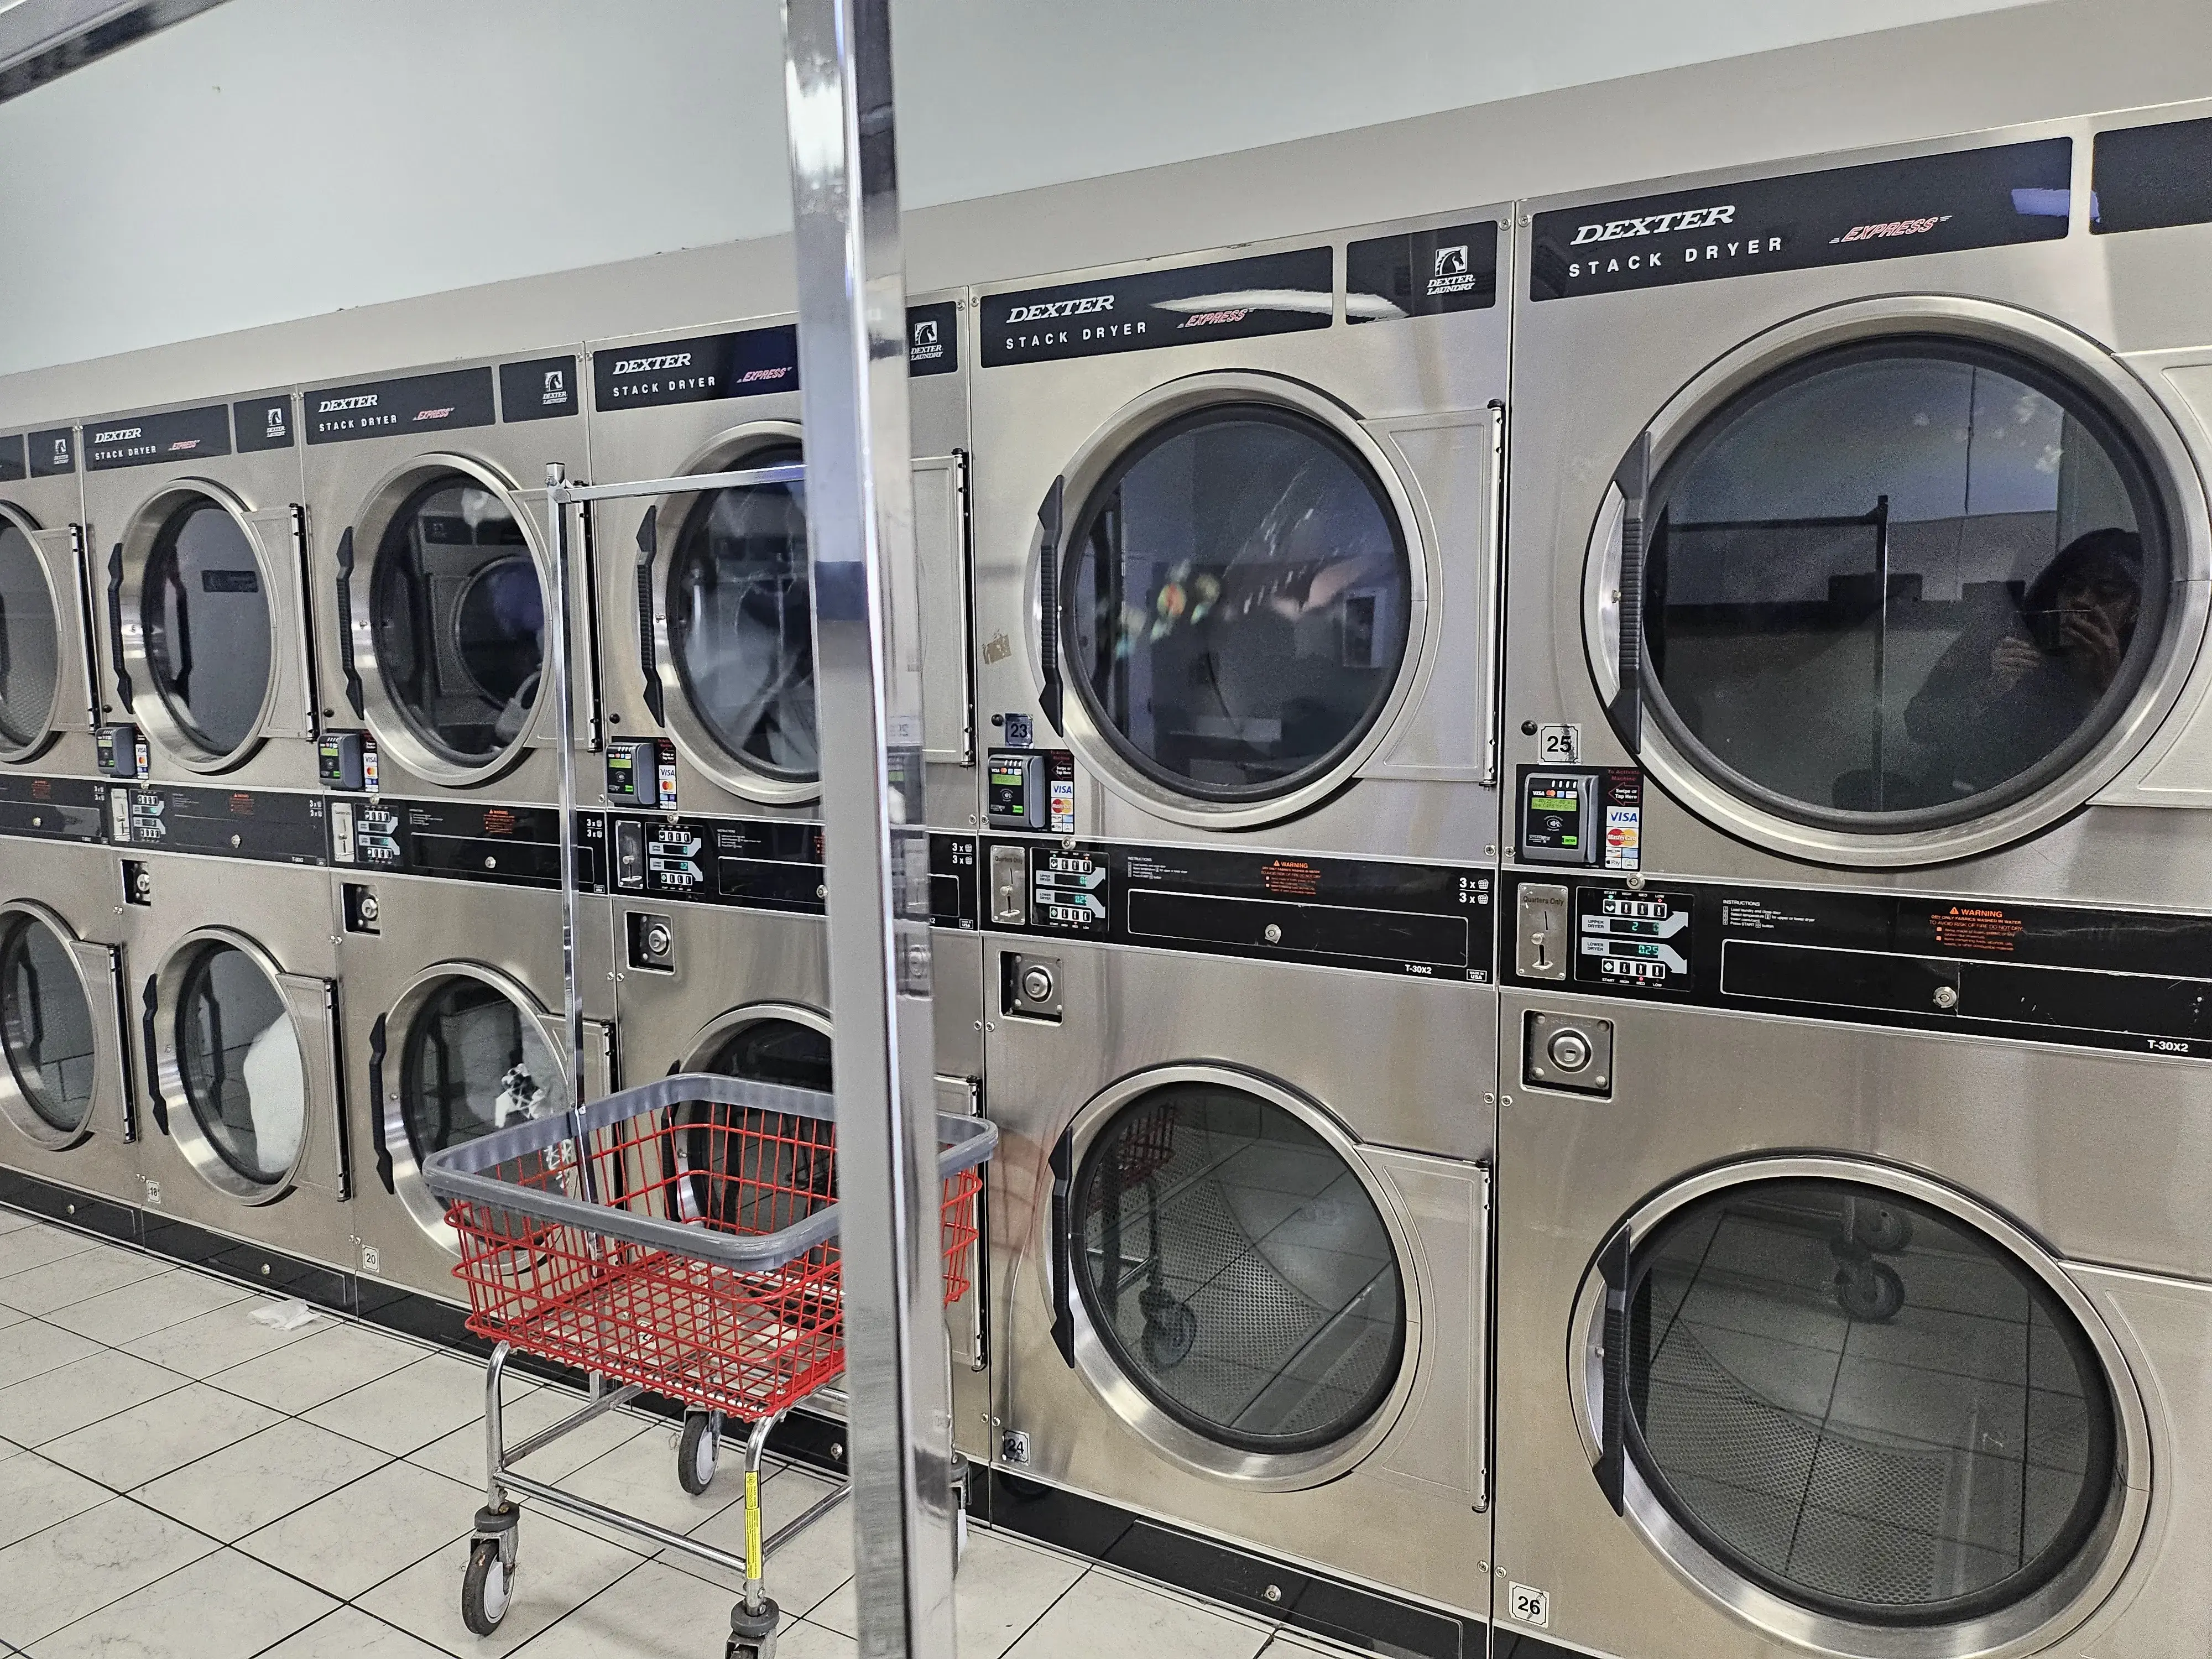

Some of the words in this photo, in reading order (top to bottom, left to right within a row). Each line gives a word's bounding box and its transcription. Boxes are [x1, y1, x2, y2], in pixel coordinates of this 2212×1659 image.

[1569, 205, 1735, 245] DEXTER
[1840, 217, 1938, 243] EXPRESS
[1569, 253, 1662, 277] STACK
[1685, 237, 1782, 263] DRYER
[1427, 274, 1474, 288] DEXTER
[1427, 283, 1475, 295] LAUNDRY
[1006, 295, 1115, 324] DEXTER
[1185, 308, 1248, 328] EXPRESS
[1006, 331, 1068, 349] STACK
[1083, 322, 1146, 341] DRYER
[910, 351, 943, 361] LAUNDRY
[911, 345, 942, 354] DEXTER
[612, 353, 691, 375] DEXTER
[742, 367, 787, 383] EXPRESS
[613, 383, 659, 397] STACK
[669, 376, 716, 391] DRYER
[318, 394, 378, 413] DEXTER
[417, 409, 450, 421] EXPRESS
[319, 419, 355, 432] STACK
[361, 414, 398, 427] DRYER
[95, 427, 142, 443] DEXTER
[95, 450, 123, 461] STACK
[128, 445, 156, 456] DRYER
[1010, 723, 1027, 738] 23
[1547, 735, 1572, 753] 25
[1053, 785, 1072, 794] VISA
[1610, 812, 1637, 822] VISA
[952, 842, 958, 852] 3
[952, 855, 958, 864] 3
[1459, 877, 1467, 888] 3
[1459, 892, 1467, 903] 3
[1524, 896, 1549, 904] Quarters
[1550, 898, 1564, 906] Only
[1961, 909, 2002, 918] WARNING
[1405, 964, 1432, 974] T-30X2
[2147, 1040, 2189, 1052] T-30X2
[366, 1253, 376, 1265] 20
[1008, 1438, 1024, 1455] 24
[1517, 1595, 1541, 1615] 26
